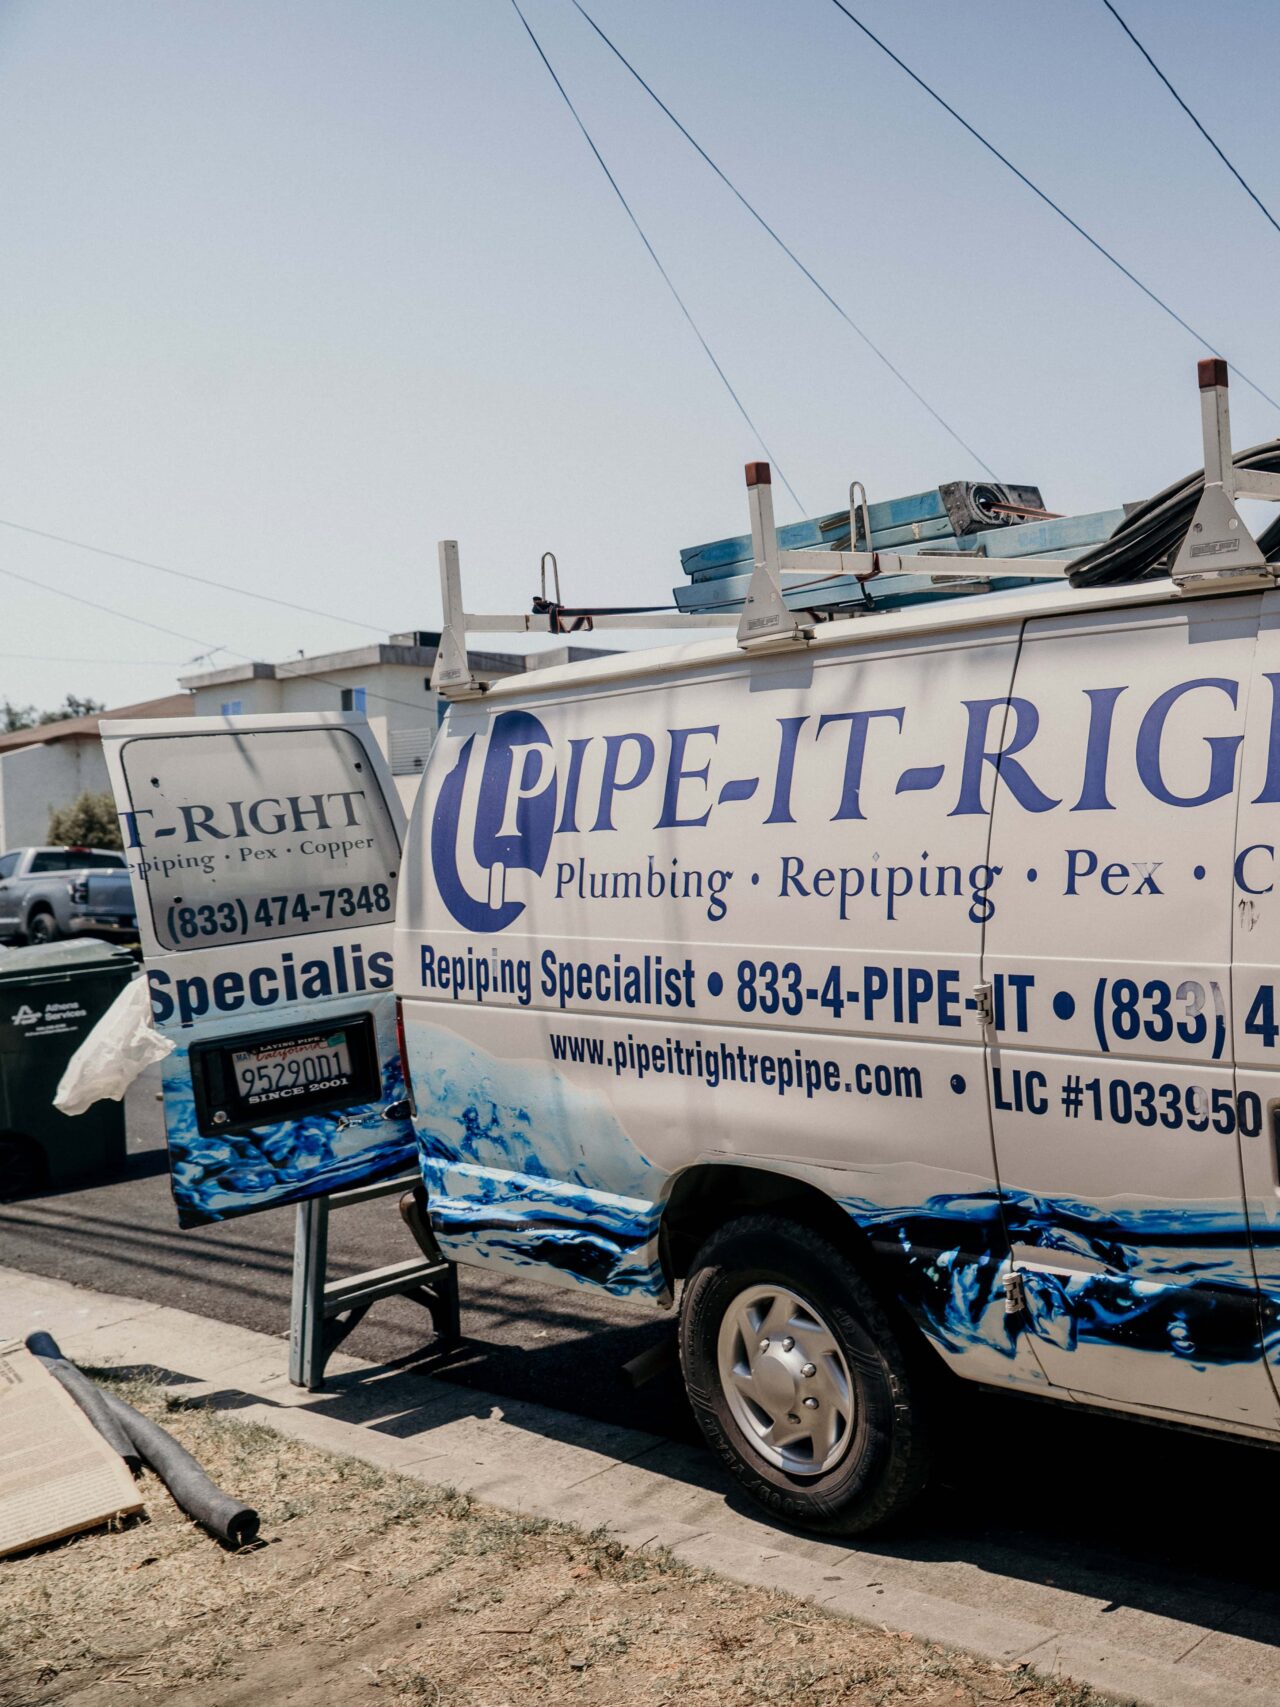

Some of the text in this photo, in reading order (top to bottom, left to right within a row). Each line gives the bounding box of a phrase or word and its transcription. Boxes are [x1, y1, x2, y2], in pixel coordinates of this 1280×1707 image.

[118, 790, 367, 849] T-RIGHT
[240, 846, 278, 862] Pex
[299, 837, 375, 860] Copper
[167, 883, 392, 944] (833) 474-7348
[554, 856, 733, 922] Plumbing
[778, 850, 1003, 925] Repiping
[1062, 848, 1165, 896] Pex
[146, 943, 394, 1028] Specialis
[421, 944, 531, 1005] Repiping
[541, 948, 696, 1009] Specialist
[737, 959, 1035, 1033] 833-4-PIPE-IT
[1093, 976, 1228, 1060] (833)
[259, 1036, 320, 1051] LAYING PIPE
[241, 1051, 343, 1098] 95290D1
[248, 1077, 349, 1104] SINCE 2001
[549, 1032, 1264, 1139] www.pipeitrightrepipe.com LIC #1033950
